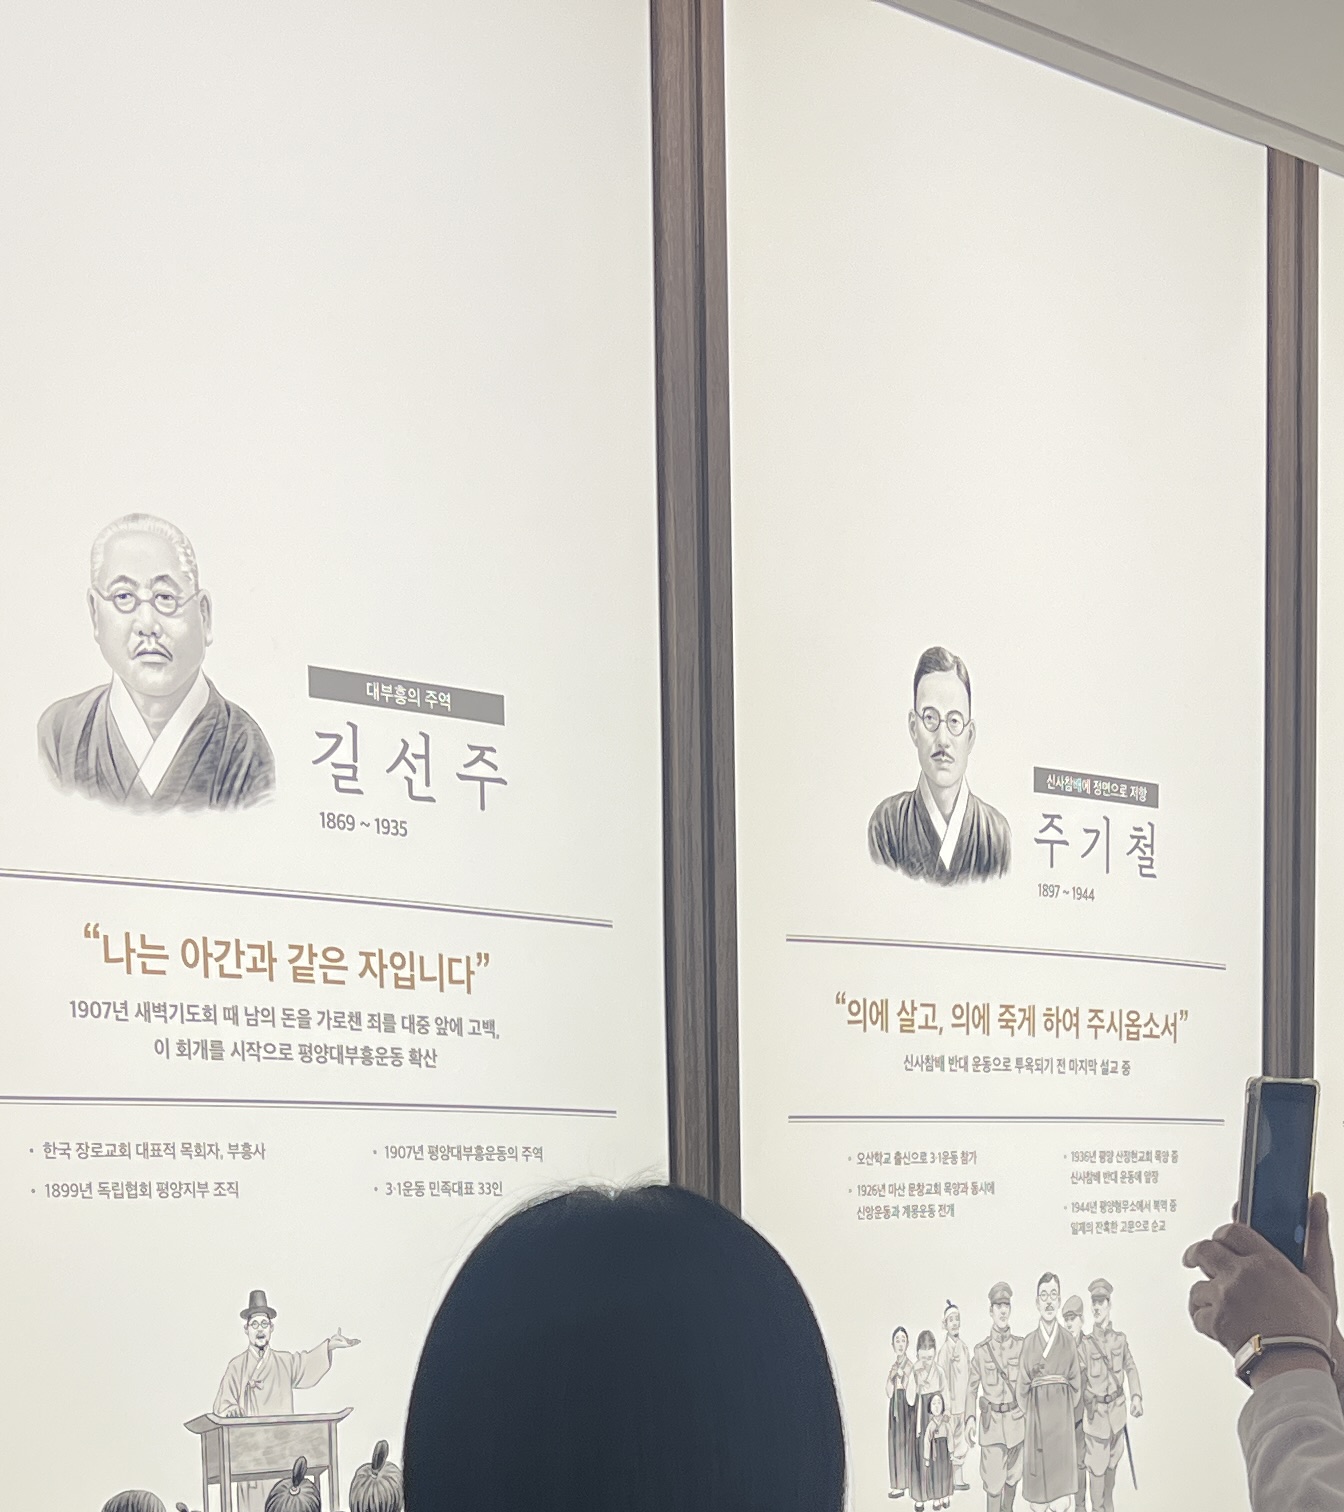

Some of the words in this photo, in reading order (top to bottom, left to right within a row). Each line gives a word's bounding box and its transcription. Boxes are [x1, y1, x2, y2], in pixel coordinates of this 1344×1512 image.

[366, 681, 420, 707] 대부흥의
[425, 690, 451, 711] 주역
[1093, 780, 1128, 798] 정면으로
[1130, 785, 1147, 802] 저항
[319, 811, 355, 831] 1869
[375, 817, 407, 837] 1935
[1037, 883, 1060, 899] 1897
[1071, 886, 1095, 901] 1944
[83, 922, 169, 975] “나는
[181, 936, 278, 982] 아간과
[287, 943, 348, 986] 같은
[358, 948, 490, 995] 자입니다”
[69, 1000, 129, 1022] 1907년
[135, 1001, 217, 1025] 새벽기도회
[223, 1005, 239, 1026] 때
[244, 1006, 276, 1028] 남의
[280, 1007, 312, 1030] 돈을
[317, 1009, 362, 1032] 가로챈
[367, 1012, 397, 1033] 죄를
[401, 1014, 431, 1035] 대중
[434, 1015, 463, 1037] 앞에
[467, 1018, 500, 1039] 고백,
[835, 991, 890, 1033] “의에
[896, 999, 944, 1036] 살고,
[951, 1002, 991, 1037] 의에
[997, 1004, 1036, 1037] 죽게
[1043, 1005, 1080, 1040] 하여
[1086, 1008, 1188, 1044] 주시옵소서”
[154, 1038, 170, 1060] 이
[175, 1038, 225, 1061] 회개를
[230, 1040, 294, 1062] 시작으로
[298, 1042, 405, 1067] 평양대부흥운동
[408, 1047, 438, 1069] 확산
[903, 1053, 945, 1073] 신사참배
[948, 1054, 969, 1073] 반대
[972, 1055, 1012, 1073] 운동으로
[1015, 1057, 1054, 1074] 투옥되기
[1056, 1058, 1066, 1075] 전
[1069, 1058, 1097, 1075] 마지막
[1100, 1059, 1118, 1076] 설교
[1121, 1060, 1131, 1077] 중
[42, 1141, 72, 1160] 한국
[75, 1142, 132, 1160] 장로교회
[135, 1141, 176, 1160] 대표적
[180, 1142, 223, 1160] 목회자,
[227, 1142, 266, 1160] 부흥사
[384, 1145, 424, 1161] 1907년
[428, 1145, 518, 1162] 평양대부흥운동의
[522, 1146, 543, 1162] 주역
[44, 1181, 93, 1199] 1899년
[97, 1181, 152, 1199] 독립협회
[156, 1181, 210, 1199] 평양지부
[213, 1181, 239, 1199] 조직
[429, 1181, 475, 1197] 민족대표
[478, 1181, 503, 1197] 33인
[857, 1182, 886, 1197] 1926년
